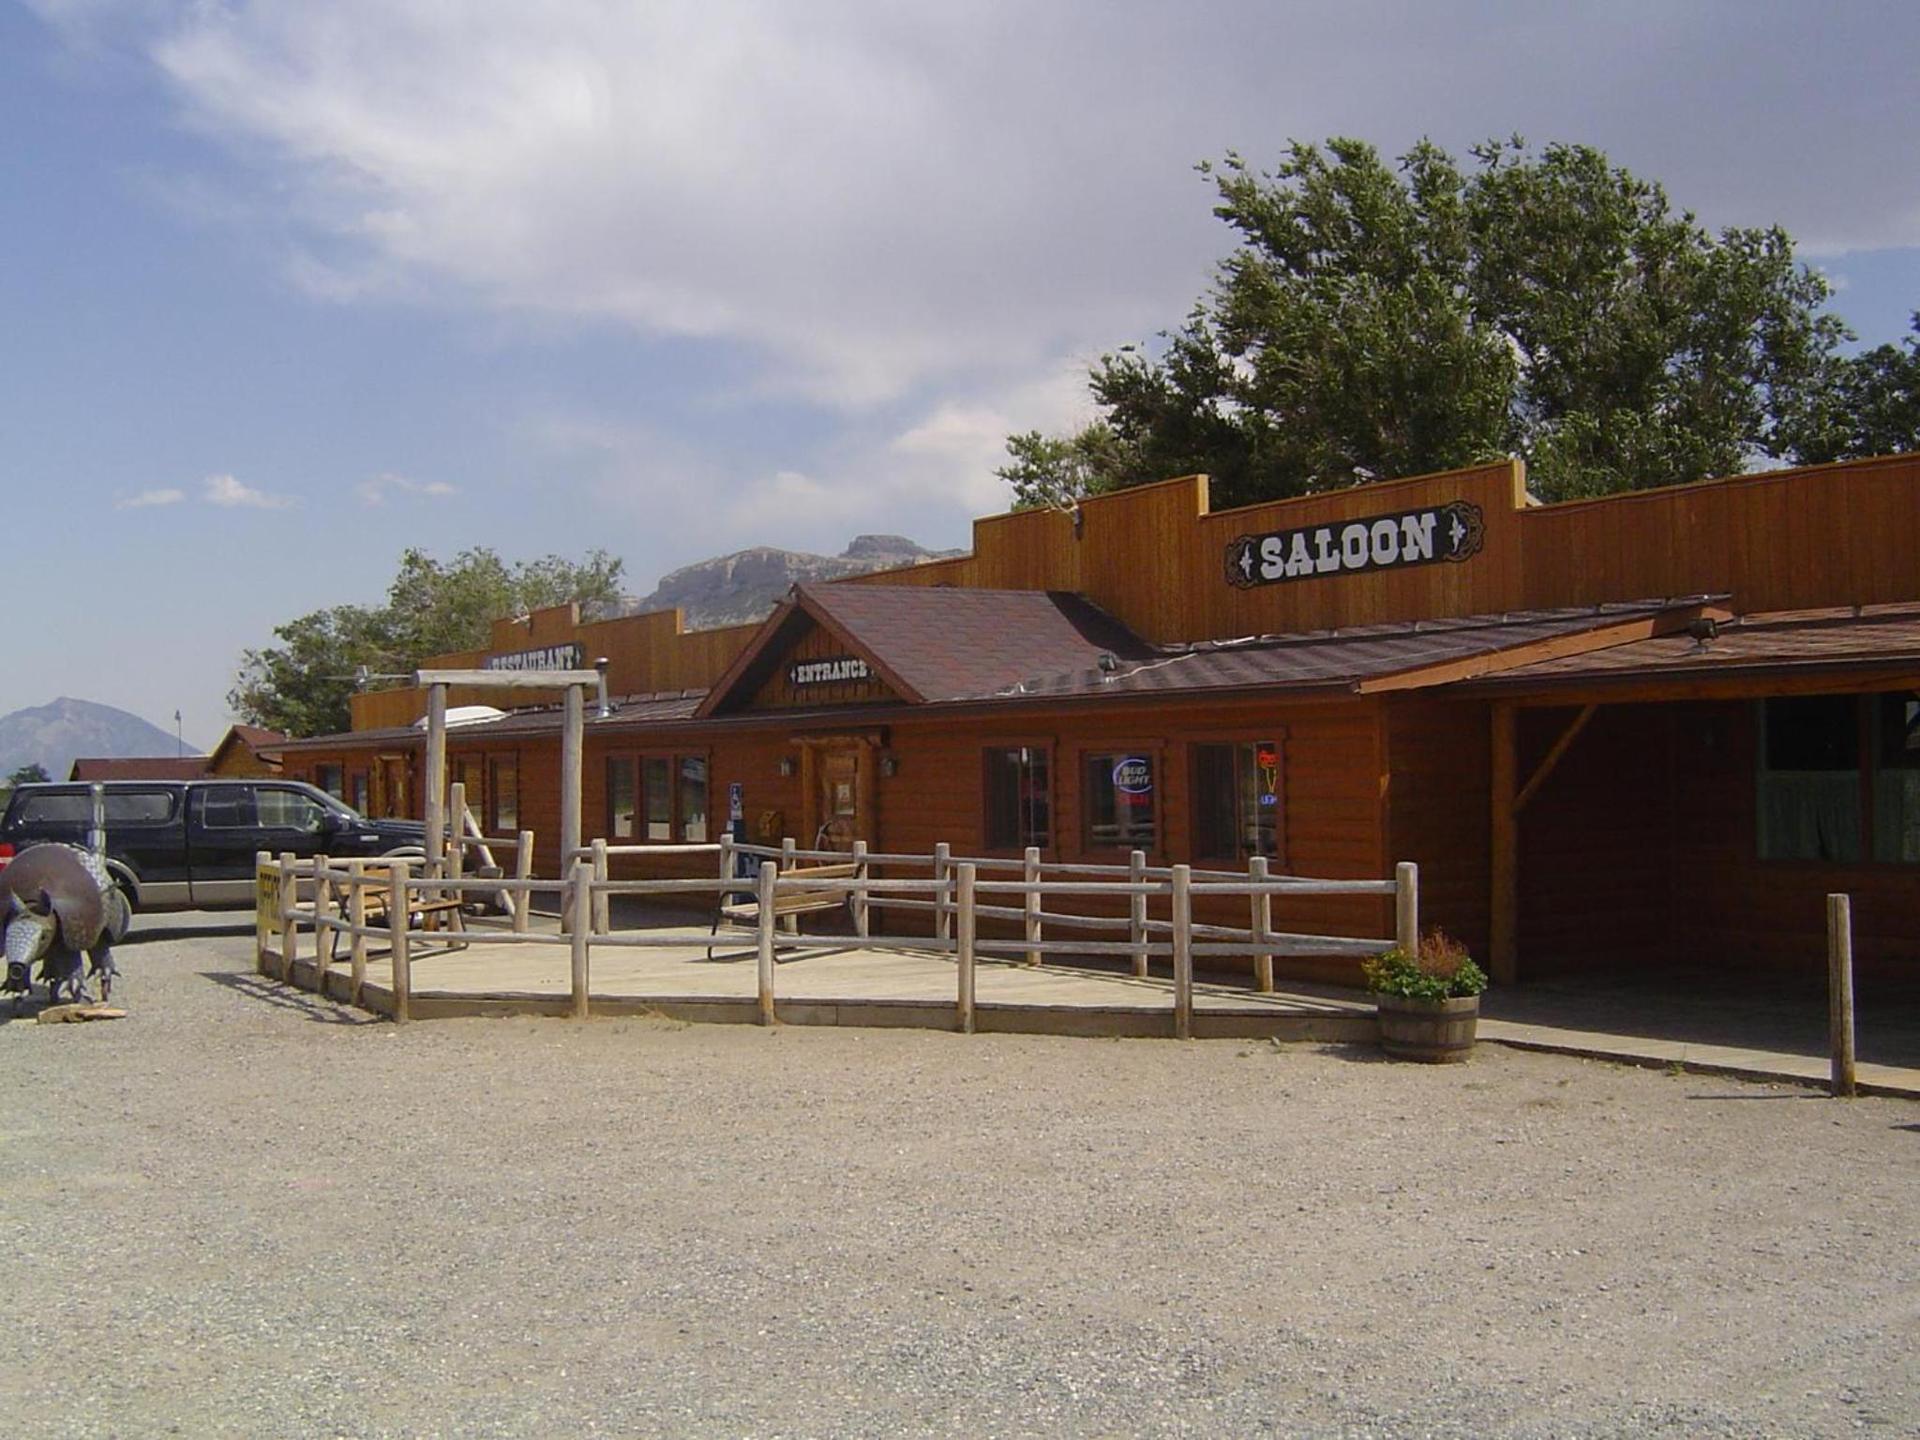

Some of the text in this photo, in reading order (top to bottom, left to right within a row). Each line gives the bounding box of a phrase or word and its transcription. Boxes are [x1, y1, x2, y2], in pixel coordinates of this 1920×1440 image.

[1260, 512, 1436, 580] SALOON
[797, 660, 868, 683] ENTRANCE
[1121, 766, 1147, 775] BUD
[1118, 775, 1150, 785] LIGHT
